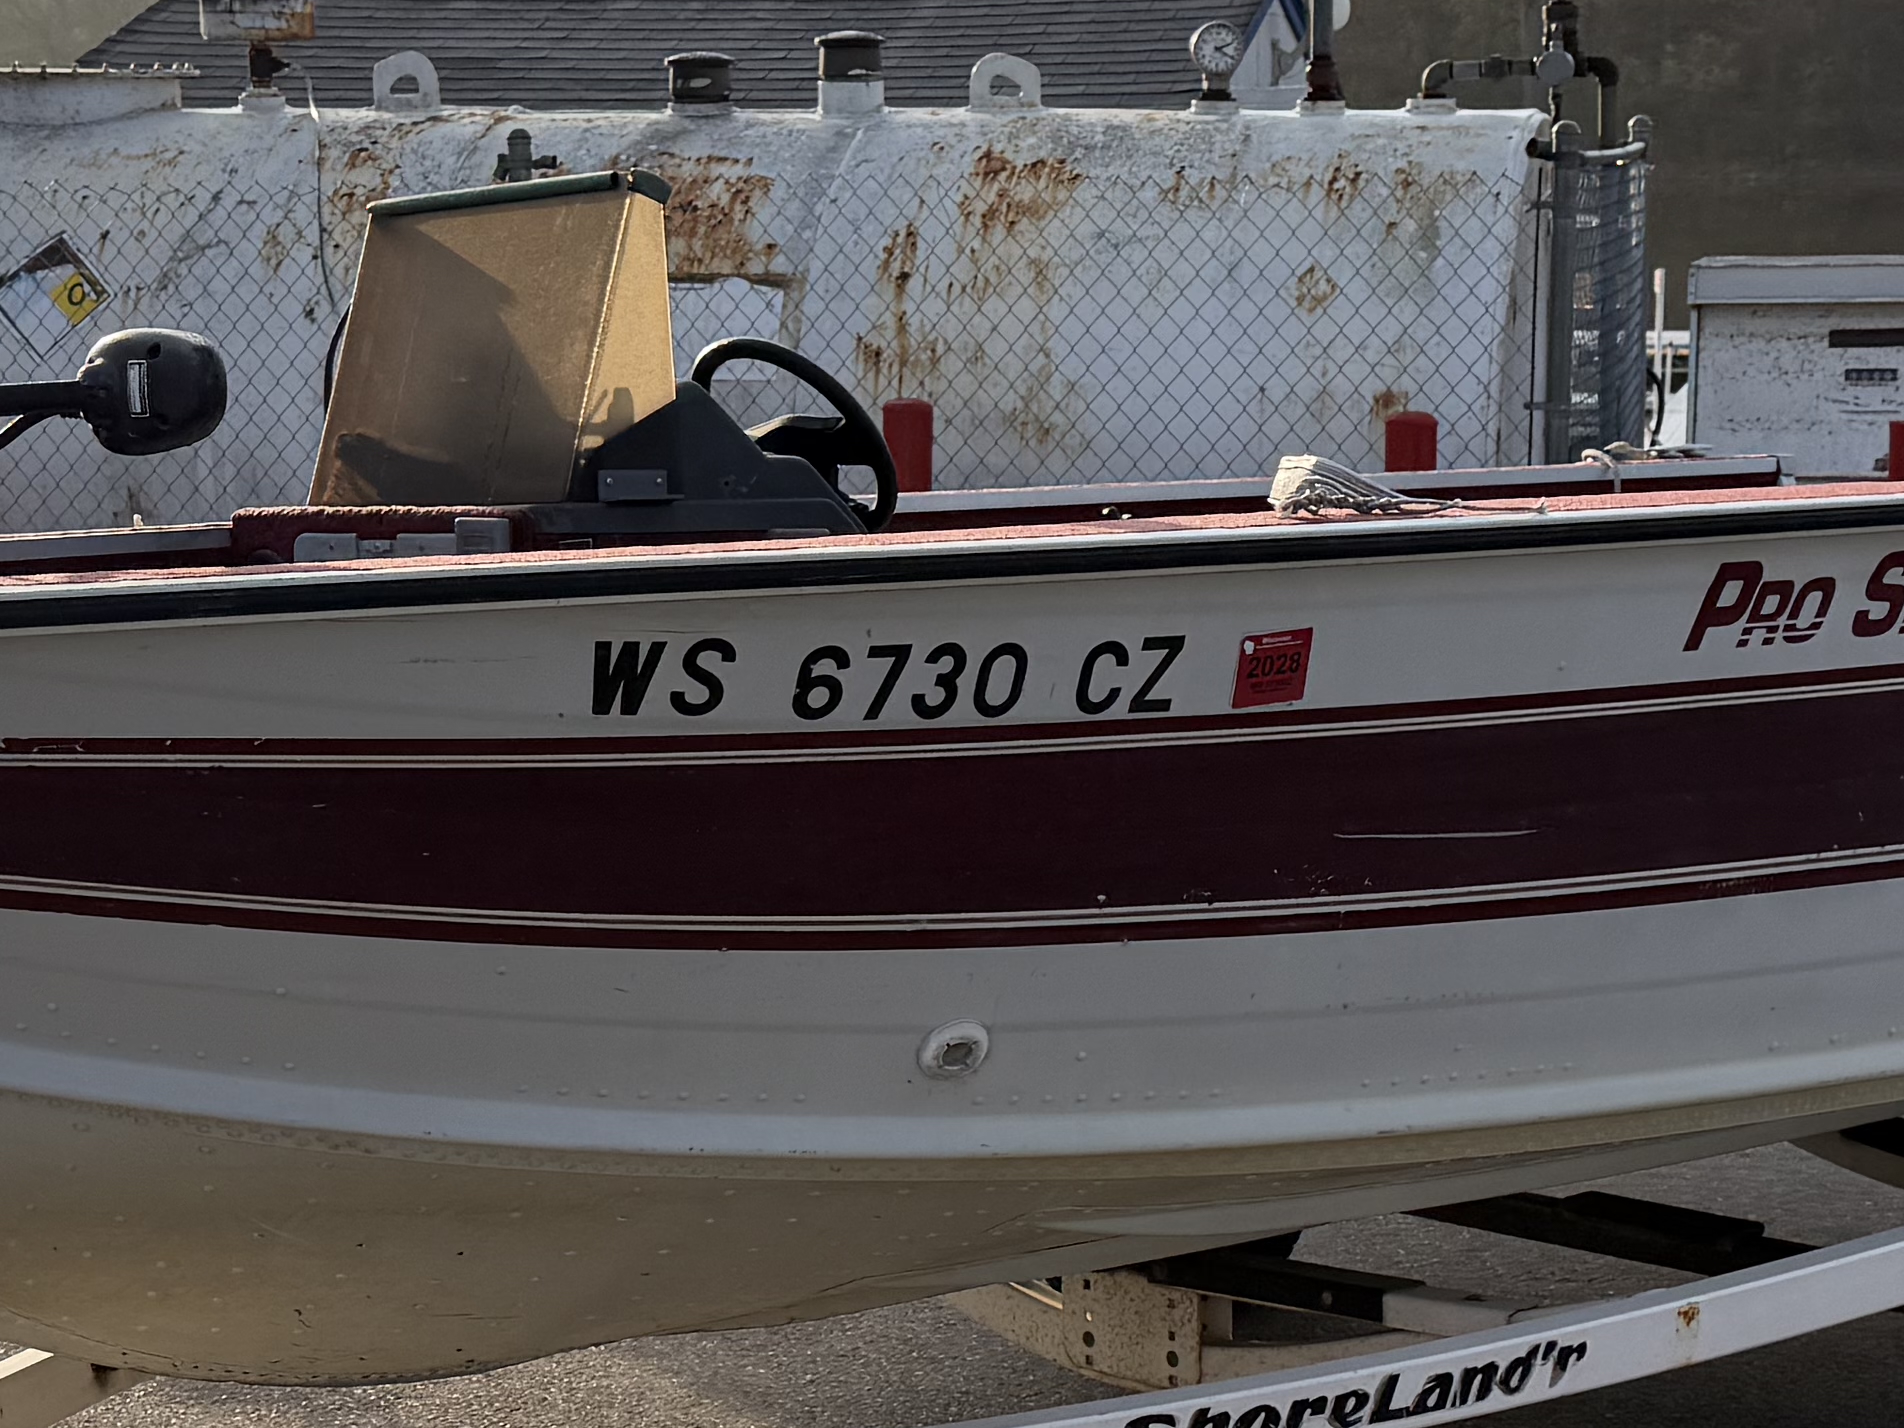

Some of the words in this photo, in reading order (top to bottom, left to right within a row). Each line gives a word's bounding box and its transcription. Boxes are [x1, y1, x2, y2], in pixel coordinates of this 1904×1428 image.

[591, 636, 738, 718] WS
[790, 641, 1030, 722] 6730
[1074, 633, 1187, 716] CZ
[1246, 651, 1303, 680] 2028
